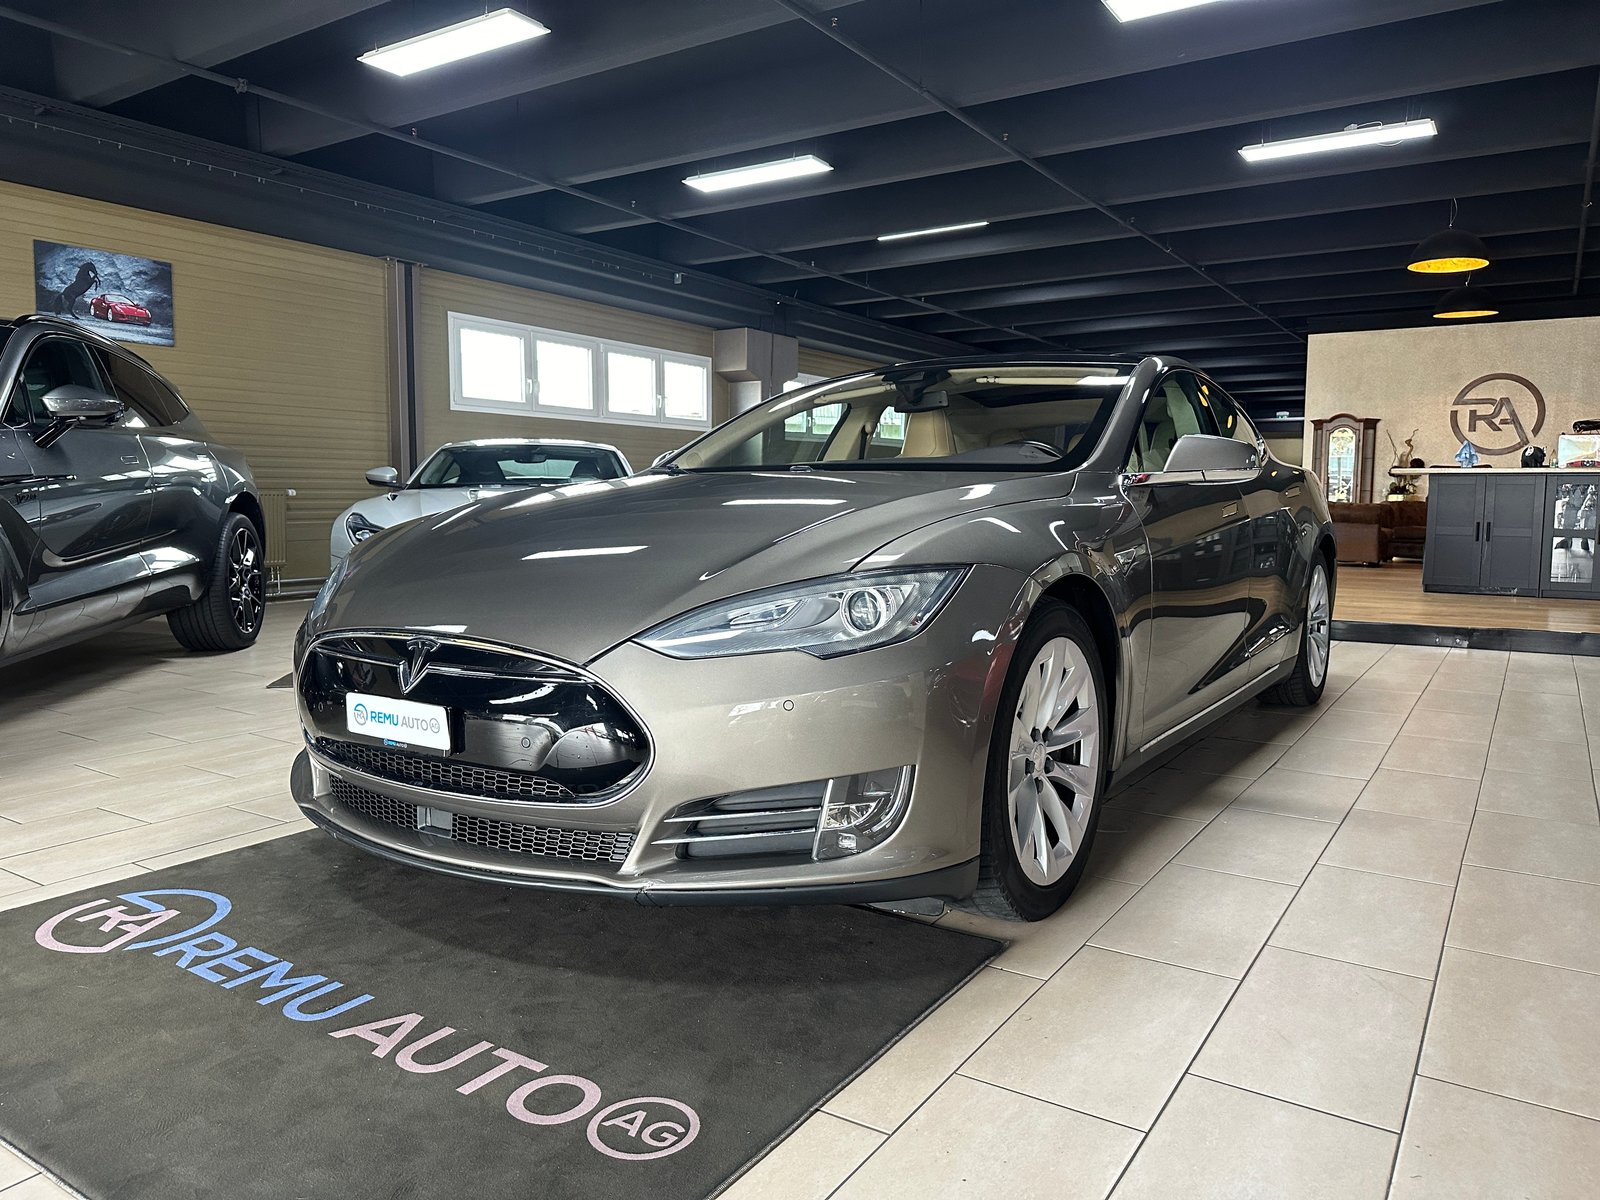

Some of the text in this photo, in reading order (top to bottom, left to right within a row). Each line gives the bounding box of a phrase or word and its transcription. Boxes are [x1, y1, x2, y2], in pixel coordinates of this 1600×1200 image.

[370, 710, 399, 726] REMU
[400, 715, 429, 731] AUTO
[153, 931, 375, 1022] REMU
[327, 1012, 602, 1126] AUTO
[601, 1110, 686, 1147] AG
